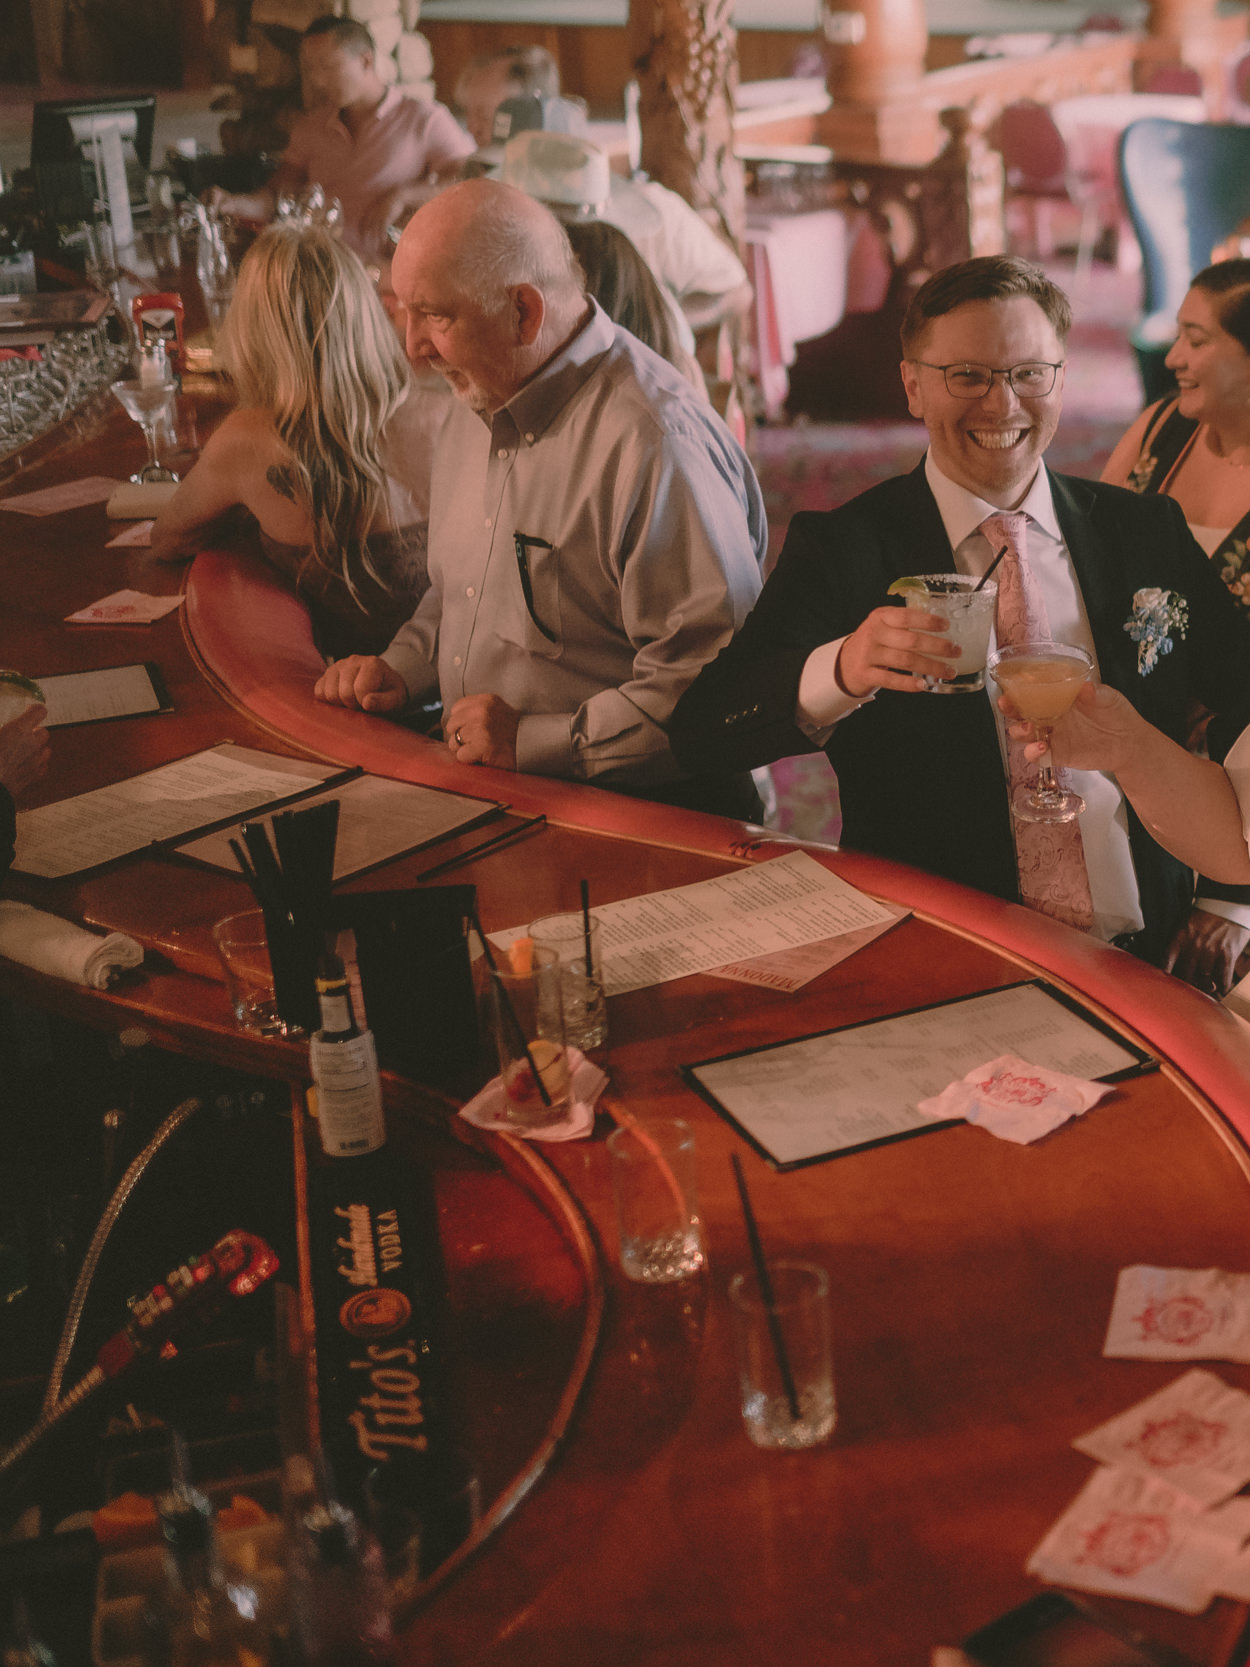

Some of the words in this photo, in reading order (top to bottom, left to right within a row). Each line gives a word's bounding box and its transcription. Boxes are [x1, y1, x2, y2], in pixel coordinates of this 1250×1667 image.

[721, 965, 801, 989] MADONNA
[377, 1209, 403, 1273] VODKA
[348, 1344, 428, 1462] Tito's
